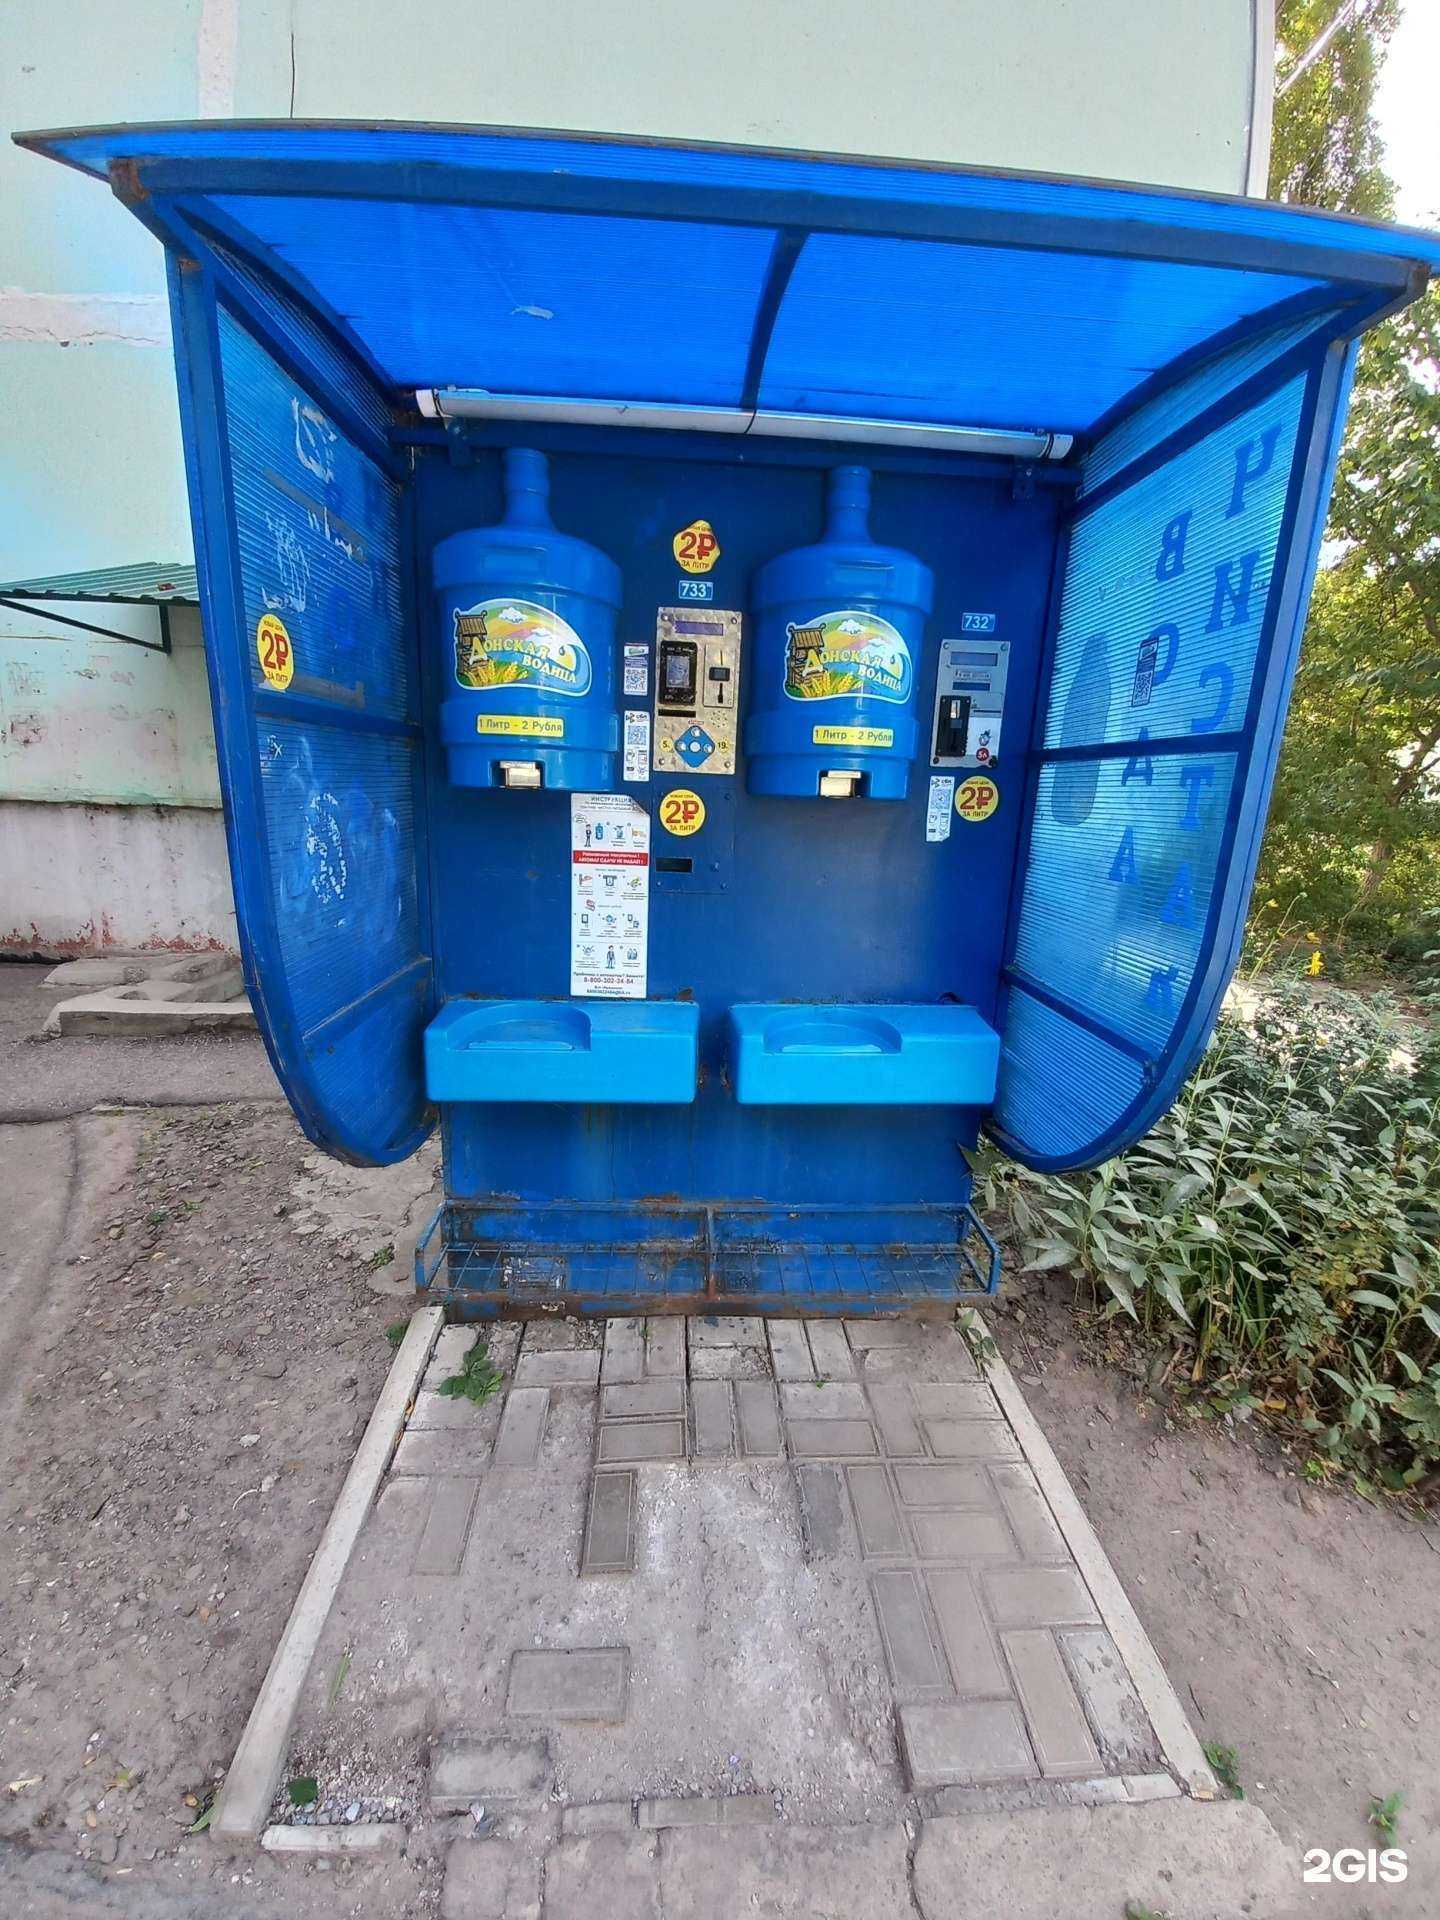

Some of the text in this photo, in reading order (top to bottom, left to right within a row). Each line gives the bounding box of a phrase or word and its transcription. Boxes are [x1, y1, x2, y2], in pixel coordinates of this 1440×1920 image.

[681, 583, 707, 597] 733
[965, 615, 989, 629] 732
[479, 719, 483, 728] 1
[486, 719, 510, 731] Литр
[522, 720, 528, 730] 2
[532, 721, 562, 732] Рубля
[815, 729, 819, 738] 1
[823, 729, 847, 741] Литр
[858, 731, 864, 740] 2
[867, 731, 892, 742] Рубля
